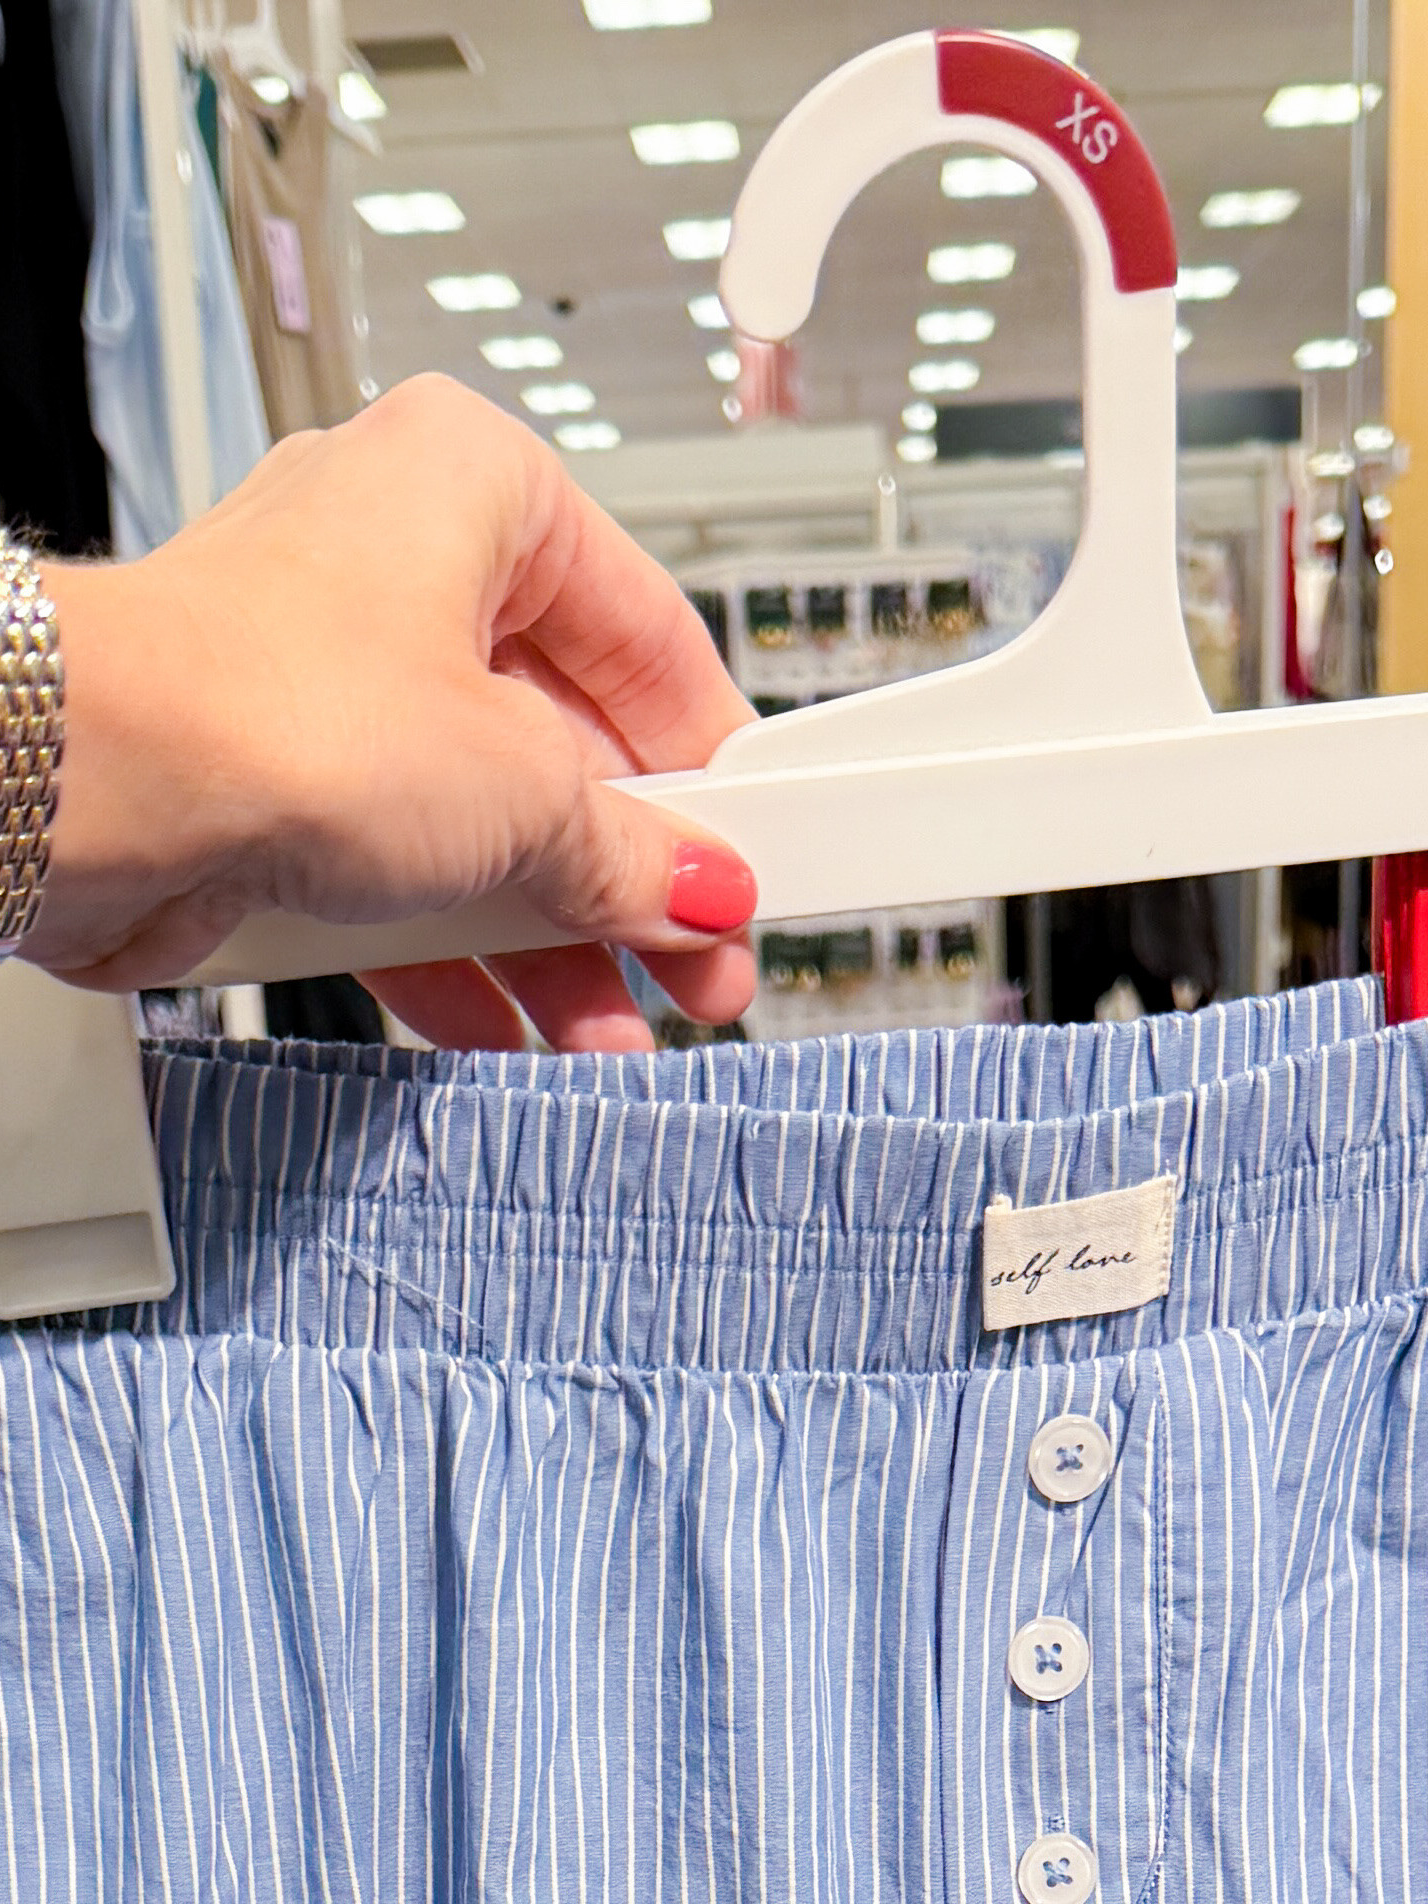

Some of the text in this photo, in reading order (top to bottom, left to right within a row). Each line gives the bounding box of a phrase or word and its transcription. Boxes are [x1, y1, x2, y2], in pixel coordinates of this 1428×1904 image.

[1055, 91, 1118, 164] XS
[991, 1244, 1136, 1295] self love
